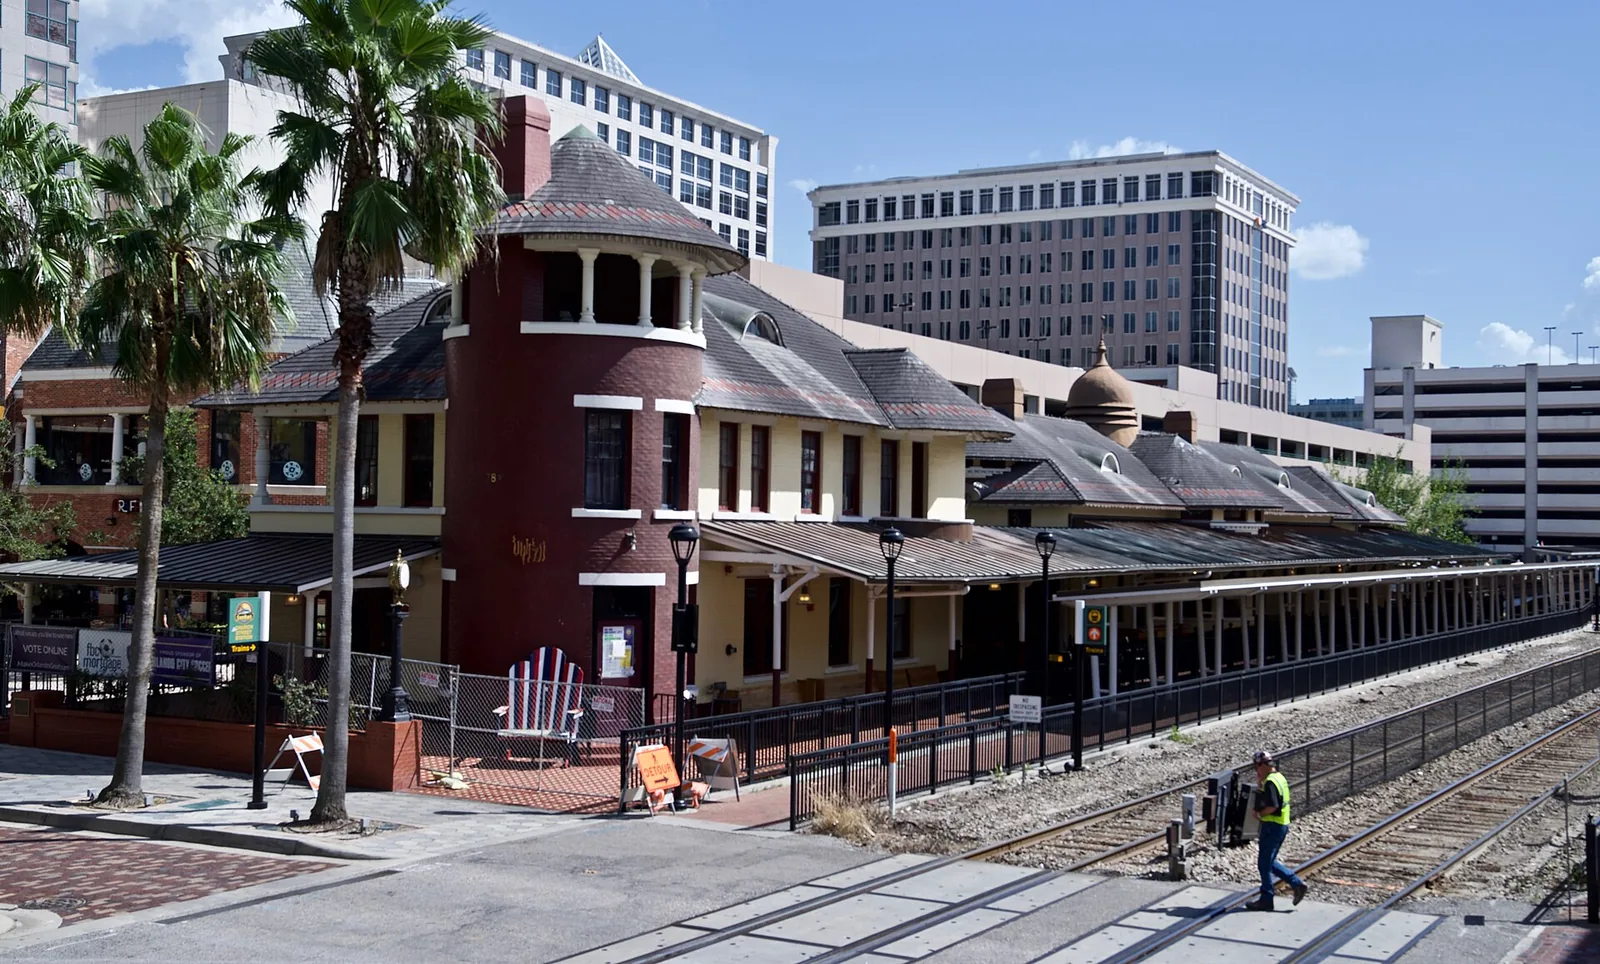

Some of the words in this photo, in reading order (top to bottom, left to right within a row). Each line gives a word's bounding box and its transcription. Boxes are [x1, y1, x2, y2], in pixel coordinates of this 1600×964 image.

[22, 644, 43, 654] VOTE
[43, 645, 68, 656] ONLINE
[86, 642, 100, 656] fbc
[231, 645, 249, 653] Trains
[1085, 646, 1104, 654] Trains
[83, 656, 121, 670] mortgage
[176, 658, 190, 671] CITY
[643, 763, 672, 778] DETOUR
